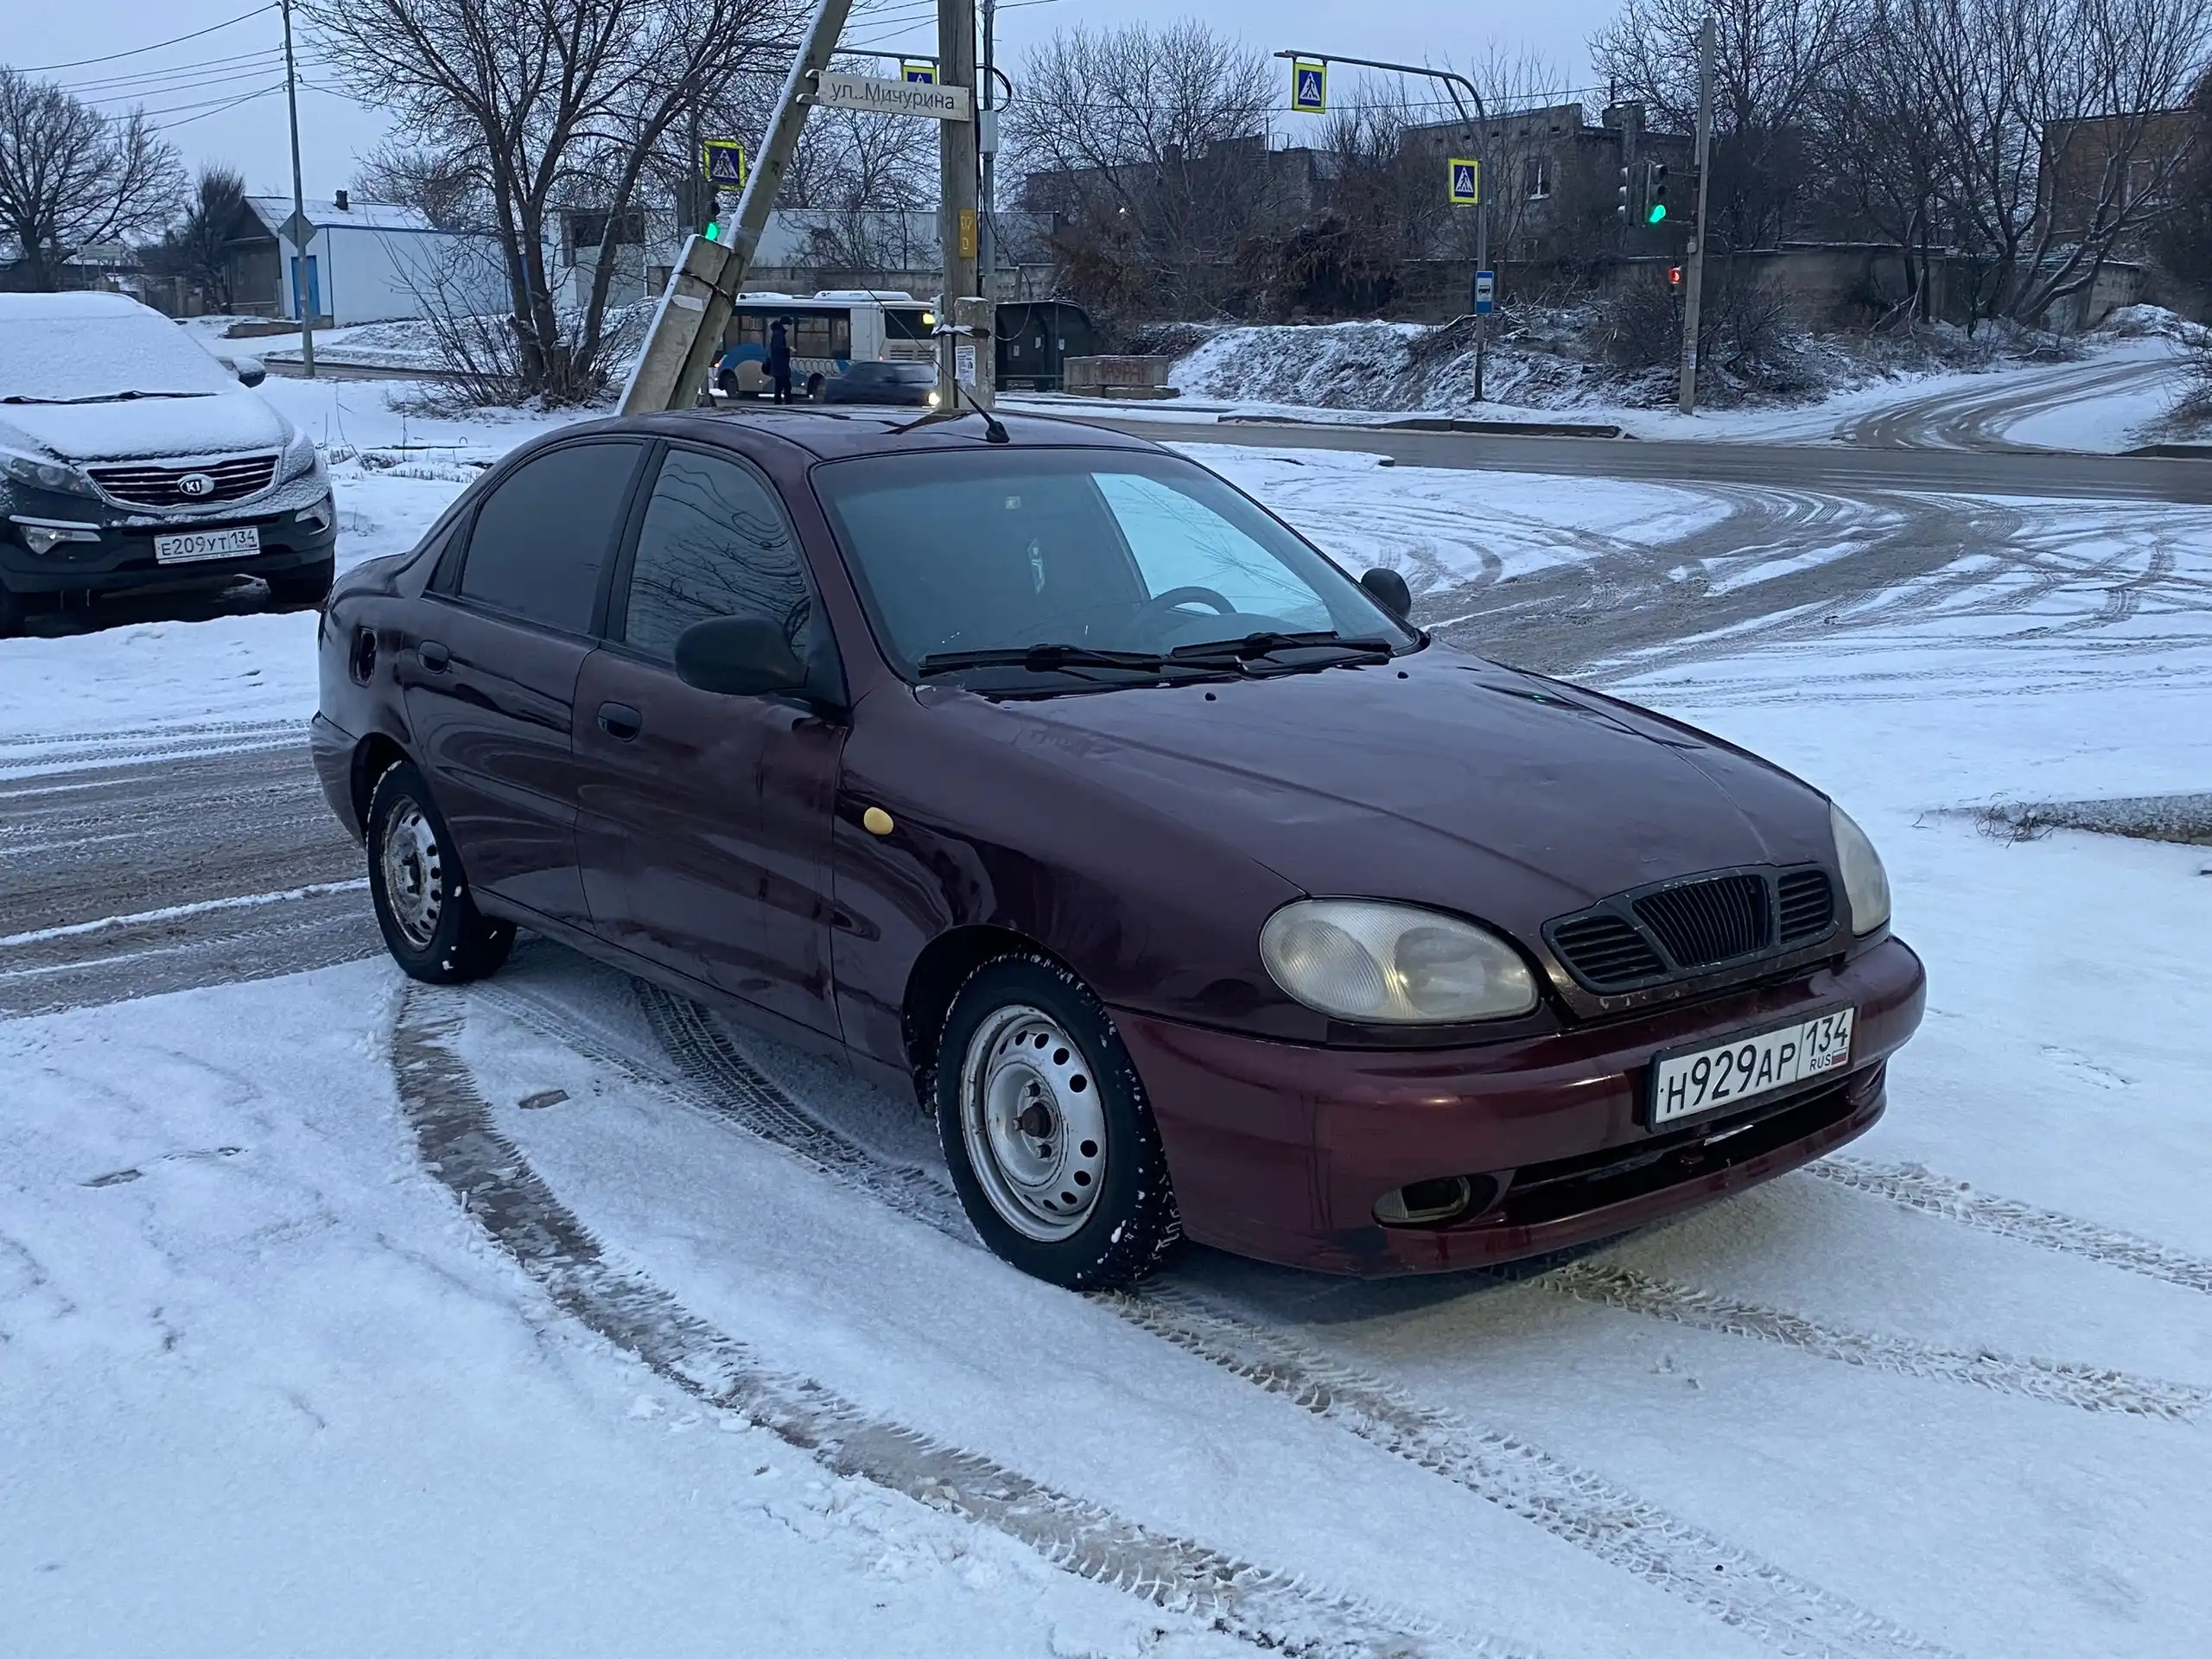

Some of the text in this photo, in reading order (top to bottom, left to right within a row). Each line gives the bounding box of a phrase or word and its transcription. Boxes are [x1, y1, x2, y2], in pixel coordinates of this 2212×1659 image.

[865, 82, 955, 110] Мичурина
[161, 530, 256, 556] Е209УТ 134
[1667, 1011, 1848, 1114] Н929АР 134
[1810, 1053, 1832, 1072] RUS
